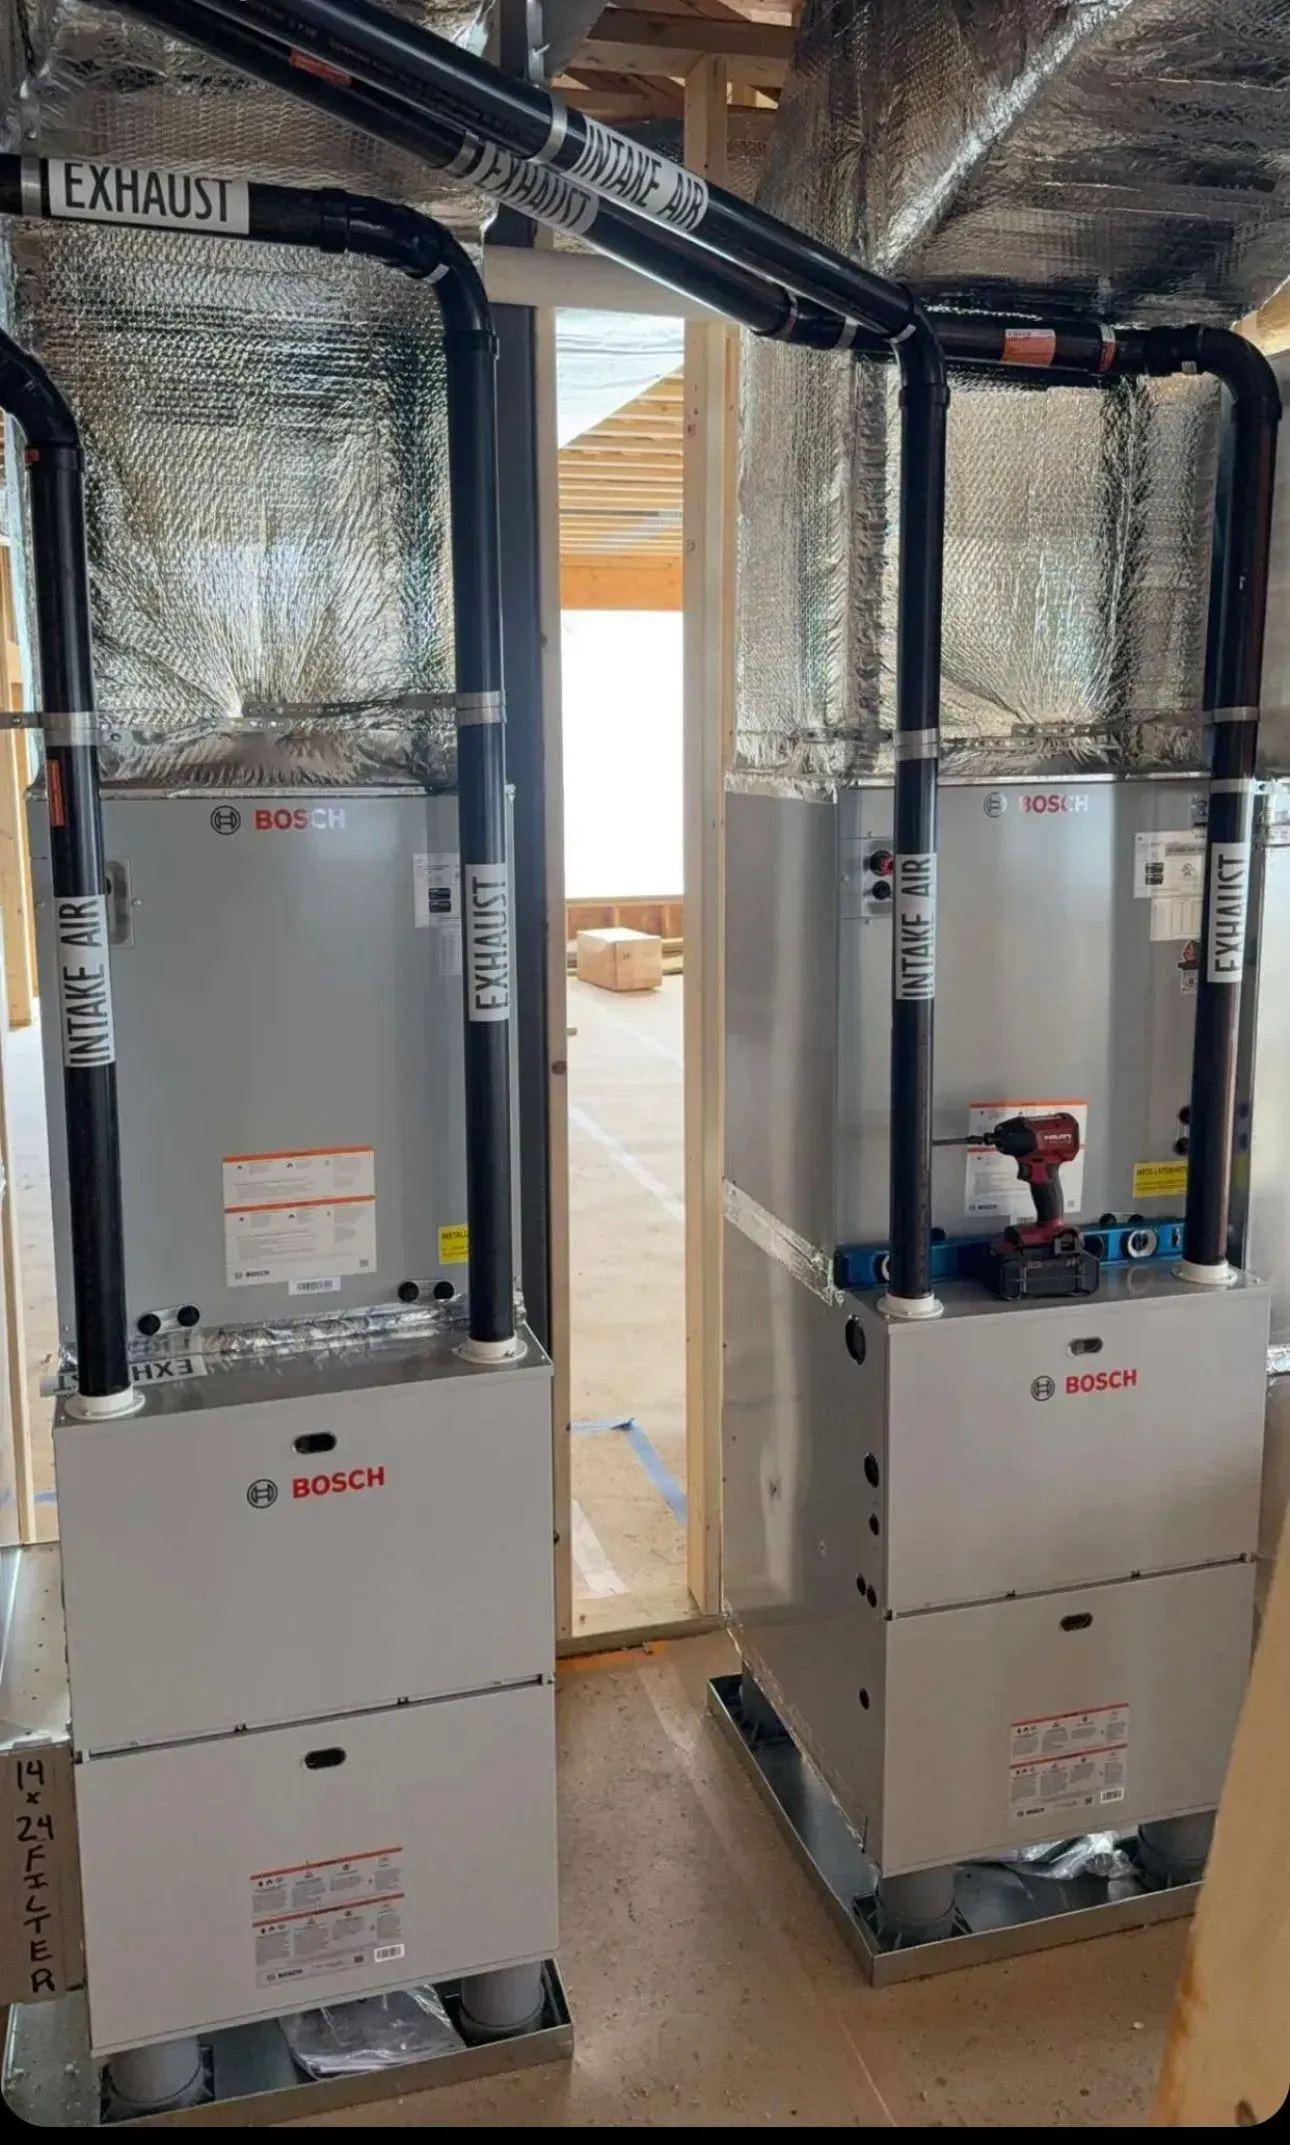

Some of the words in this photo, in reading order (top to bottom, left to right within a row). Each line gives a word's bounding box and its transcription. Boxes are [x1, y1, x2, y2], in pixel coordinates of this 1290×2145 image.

[64, 162, 233, 222] EXHAUST
[474, 150, 592, 229] EXHAUST
[573, 124, 662, 208] INTAKE
[656, 173, 706, 230] AIR
[255, 808, 346, 830] BOSCH
[1018, 794, 1090, 814] BOSCH
[901, 858, 932, 898] AIR
[58, 899, 103, 948] AIR
[1214, 853, 1245, 973] EXHAUST
[472, 875, 509, 1010] EXHAUST
[901, 912, 934, 997] INTAKE
[63, 963, 111, 1064] INTAKE
[1065, 1368, 1138, 1395] BOSCH
[292, 1465, 385, 1499] BOSCH
[17, 1760, 45, 1790] 14
[16, 1813, 54, 1842] 24
[22, 1844, 56, 1993] FILTER
